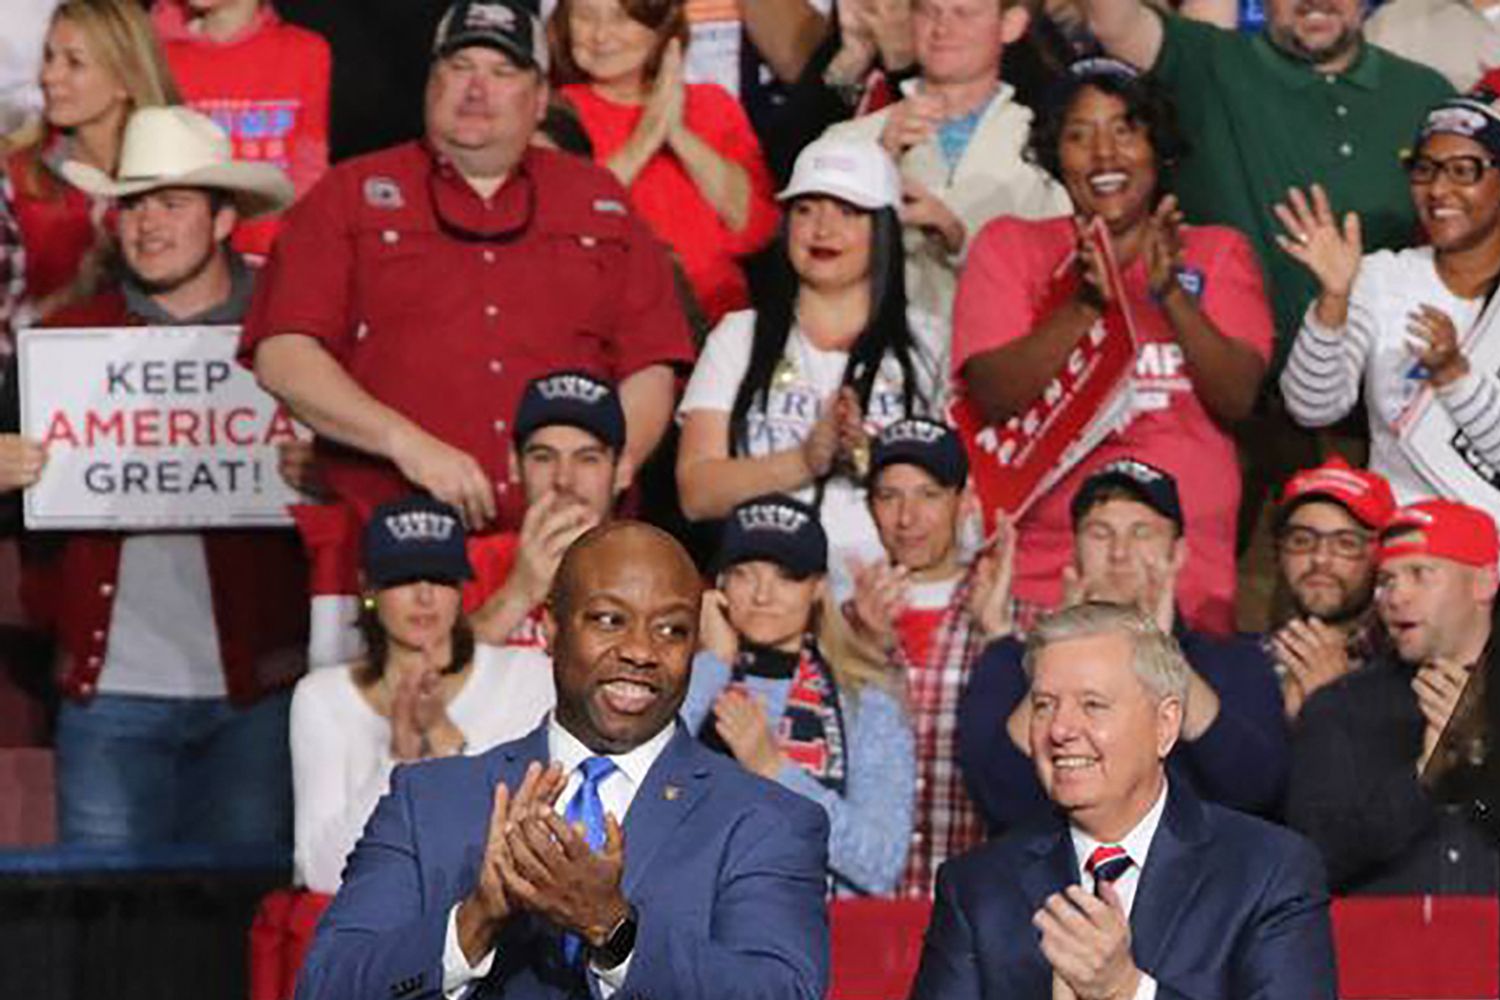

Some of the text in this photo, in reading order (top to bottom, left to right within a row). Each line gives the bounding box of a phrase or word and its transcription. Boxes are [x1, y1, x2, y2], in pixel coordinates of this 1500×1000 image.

[105, 361, 231, 394] KEEP
[43, 408, 298, 448] AMERICA
[84, 461, 262, 494] GREAT!
